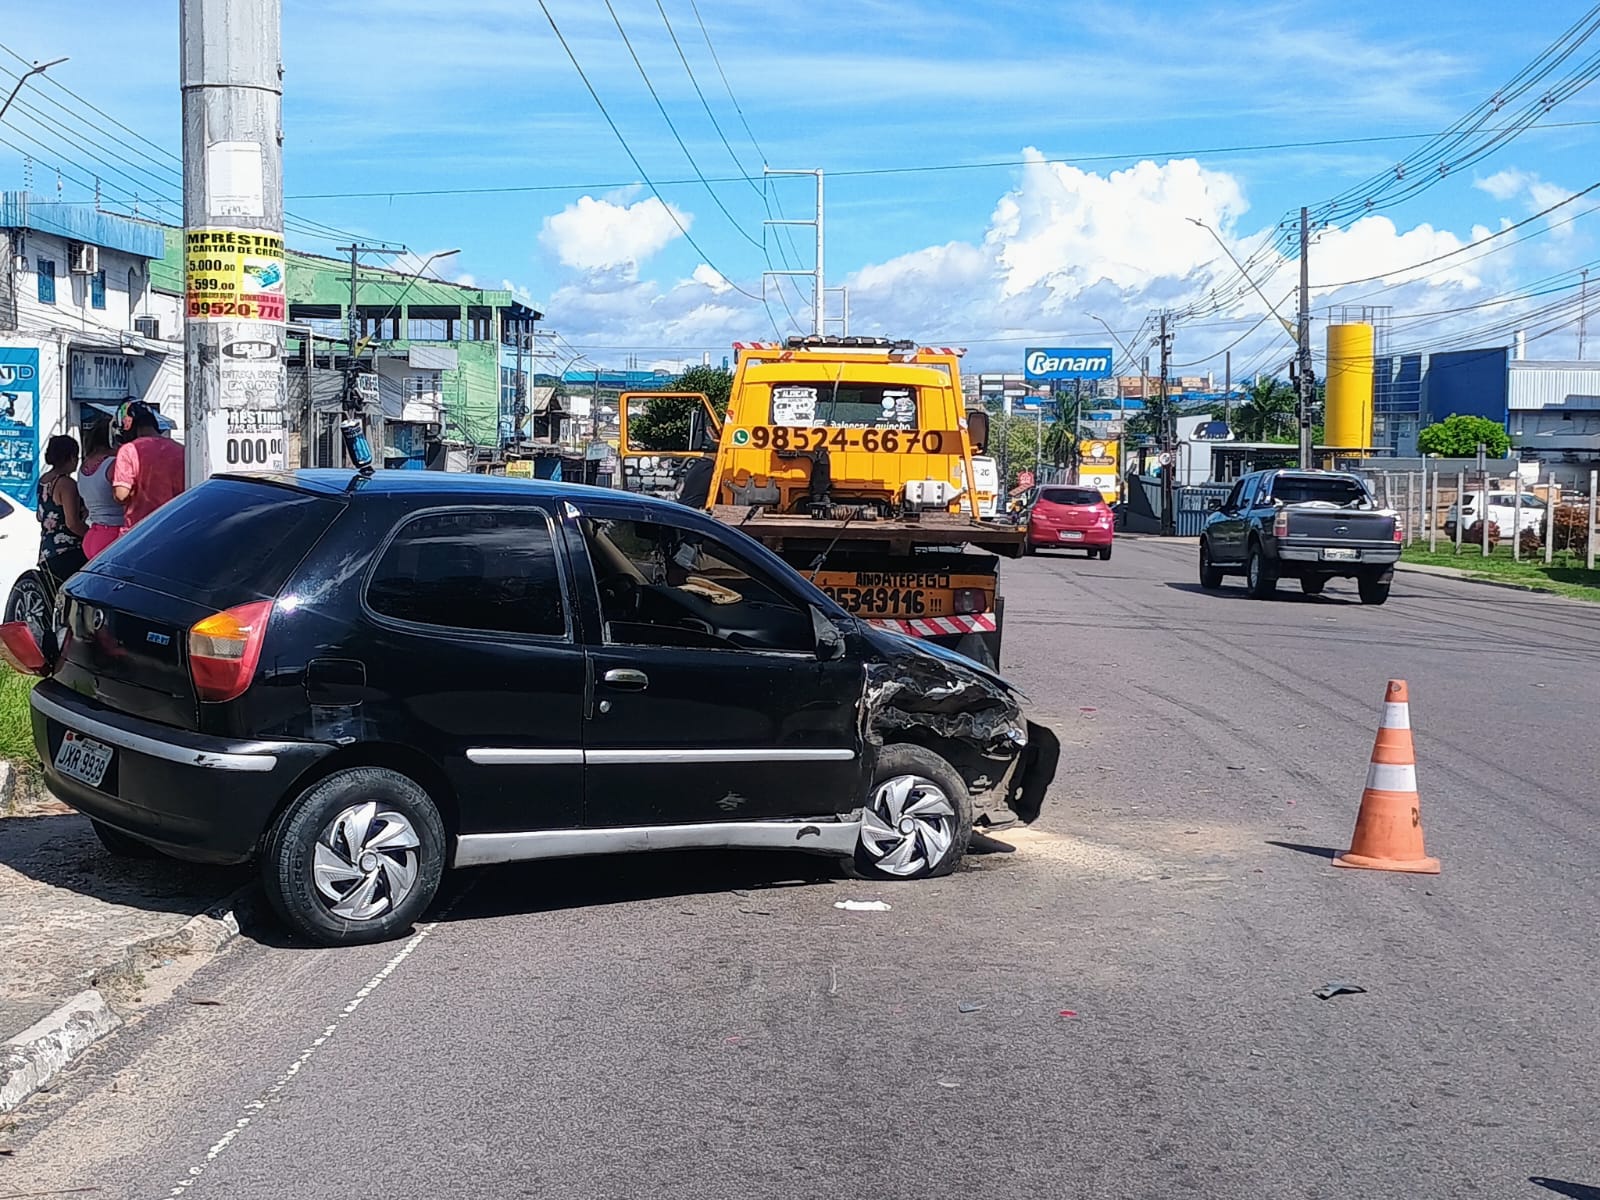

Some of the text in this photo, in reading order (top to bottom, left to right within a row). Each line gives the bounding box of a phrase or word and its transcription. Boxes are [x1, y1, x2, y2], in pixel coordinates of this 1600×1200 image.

[237, 246, 252, 255] DE
[1032, 354, 1107, 372] Ranam
[751, 426, 943, 454] 98524-6670
